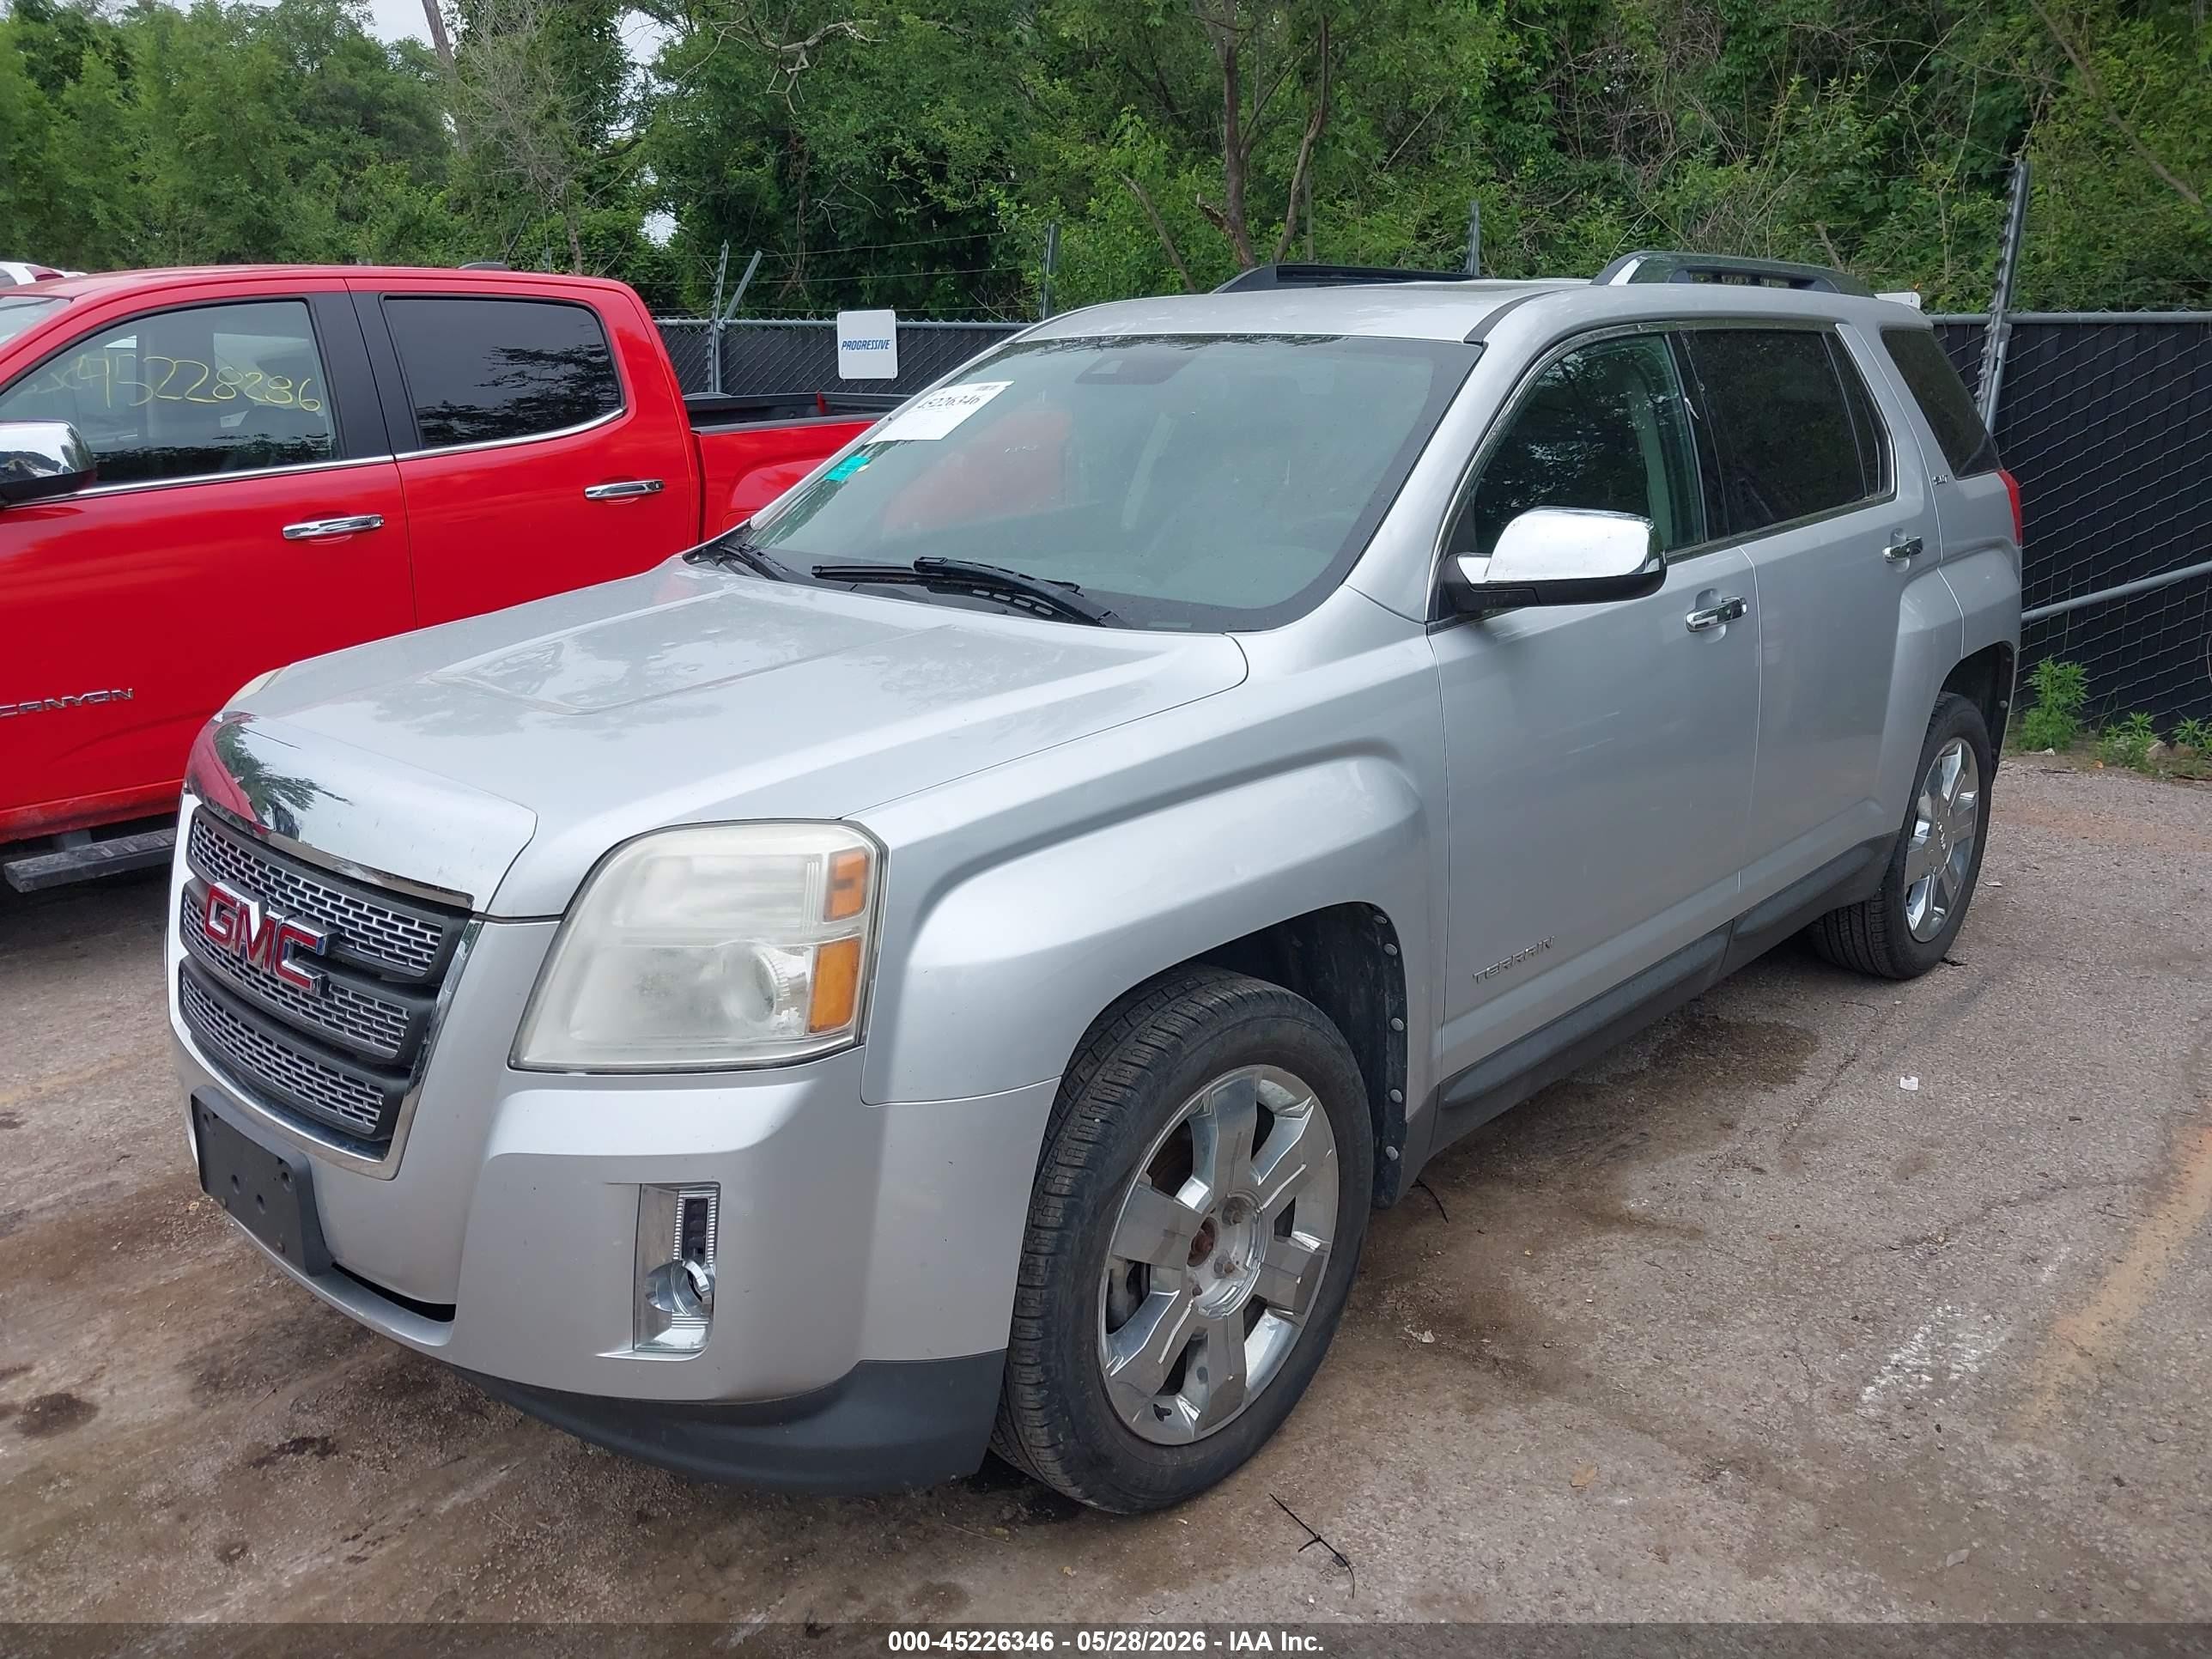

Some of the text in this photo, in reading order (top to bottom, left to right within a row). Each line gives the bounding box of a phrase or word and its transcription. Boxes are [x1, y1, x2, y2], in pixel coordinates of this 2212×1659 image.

[842, 339, 890, 350] PROGRESSIVE
[0, 688, 133, 717] CANYON
[204, 882, 328, 996] GMC
[1472, 935, 1555, 983] TERRAIN
